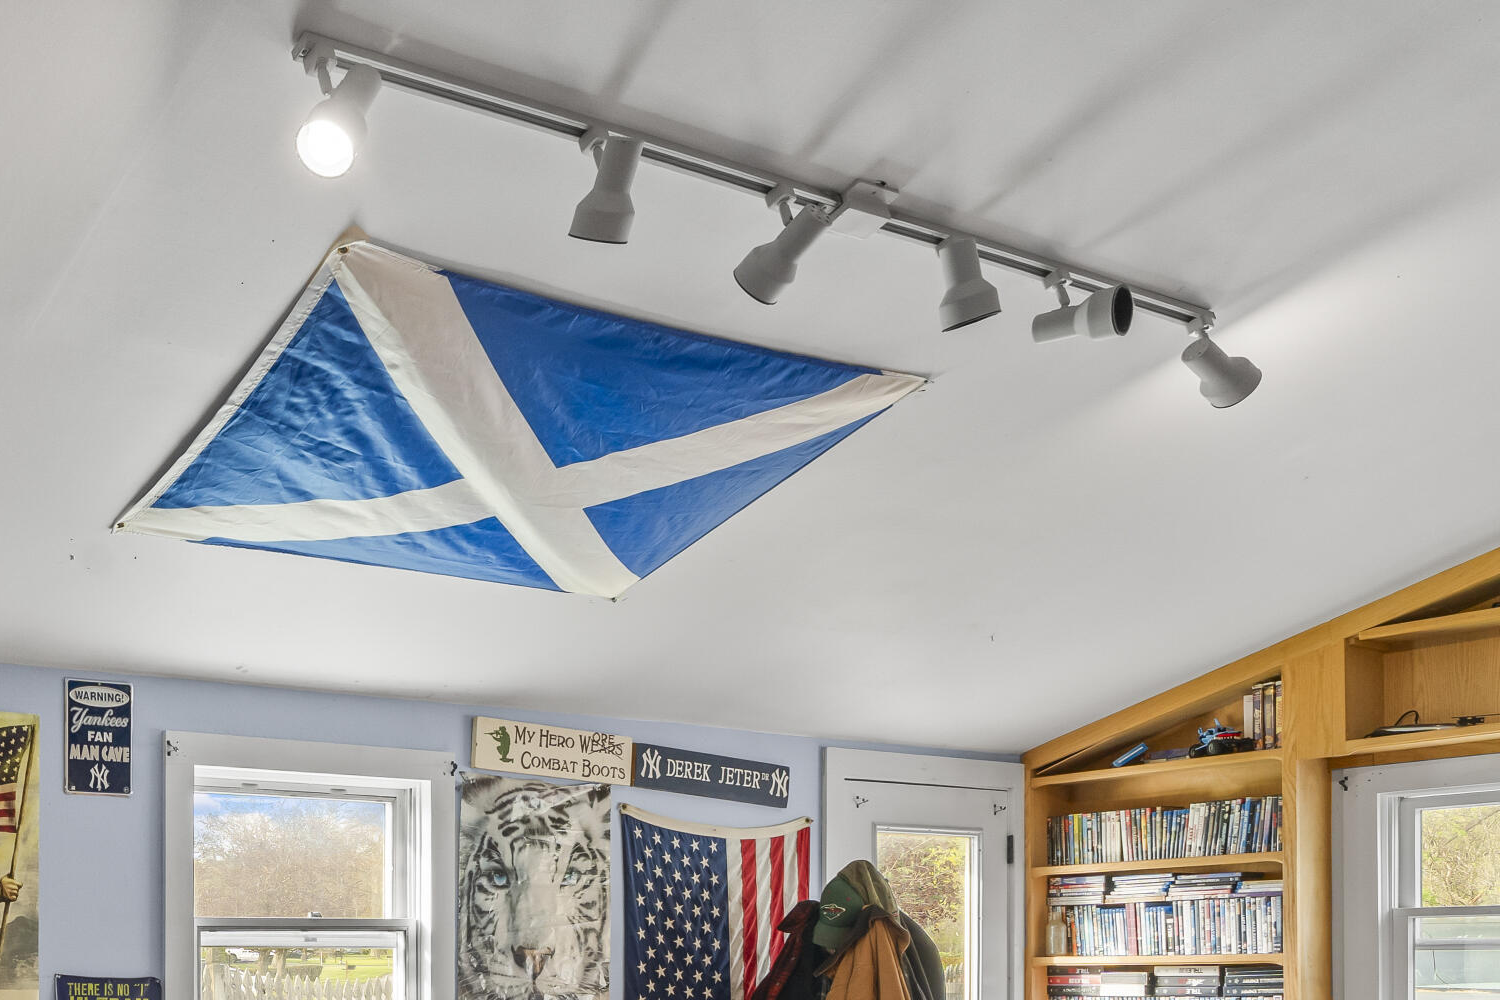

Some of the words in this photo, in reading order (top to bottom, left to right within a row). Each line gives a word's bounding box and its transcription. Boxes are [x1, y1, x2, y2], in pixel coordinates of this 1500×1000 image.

[75, 690, 124, 703] WARNING!
[70, 707, 129, 733] Yankees
[87, 730, 113, 743] FAN
[69, 743, 100, 761] MAN
[101, 745, 130, 763] CAVE
[665, 758, 713, 783] DEREK
[718, 766, 761, 790] JETER
[67, 982, 100, 996] THERE
[104, 983, 114, 996] IS
[117, 983, 130, 996] NO
